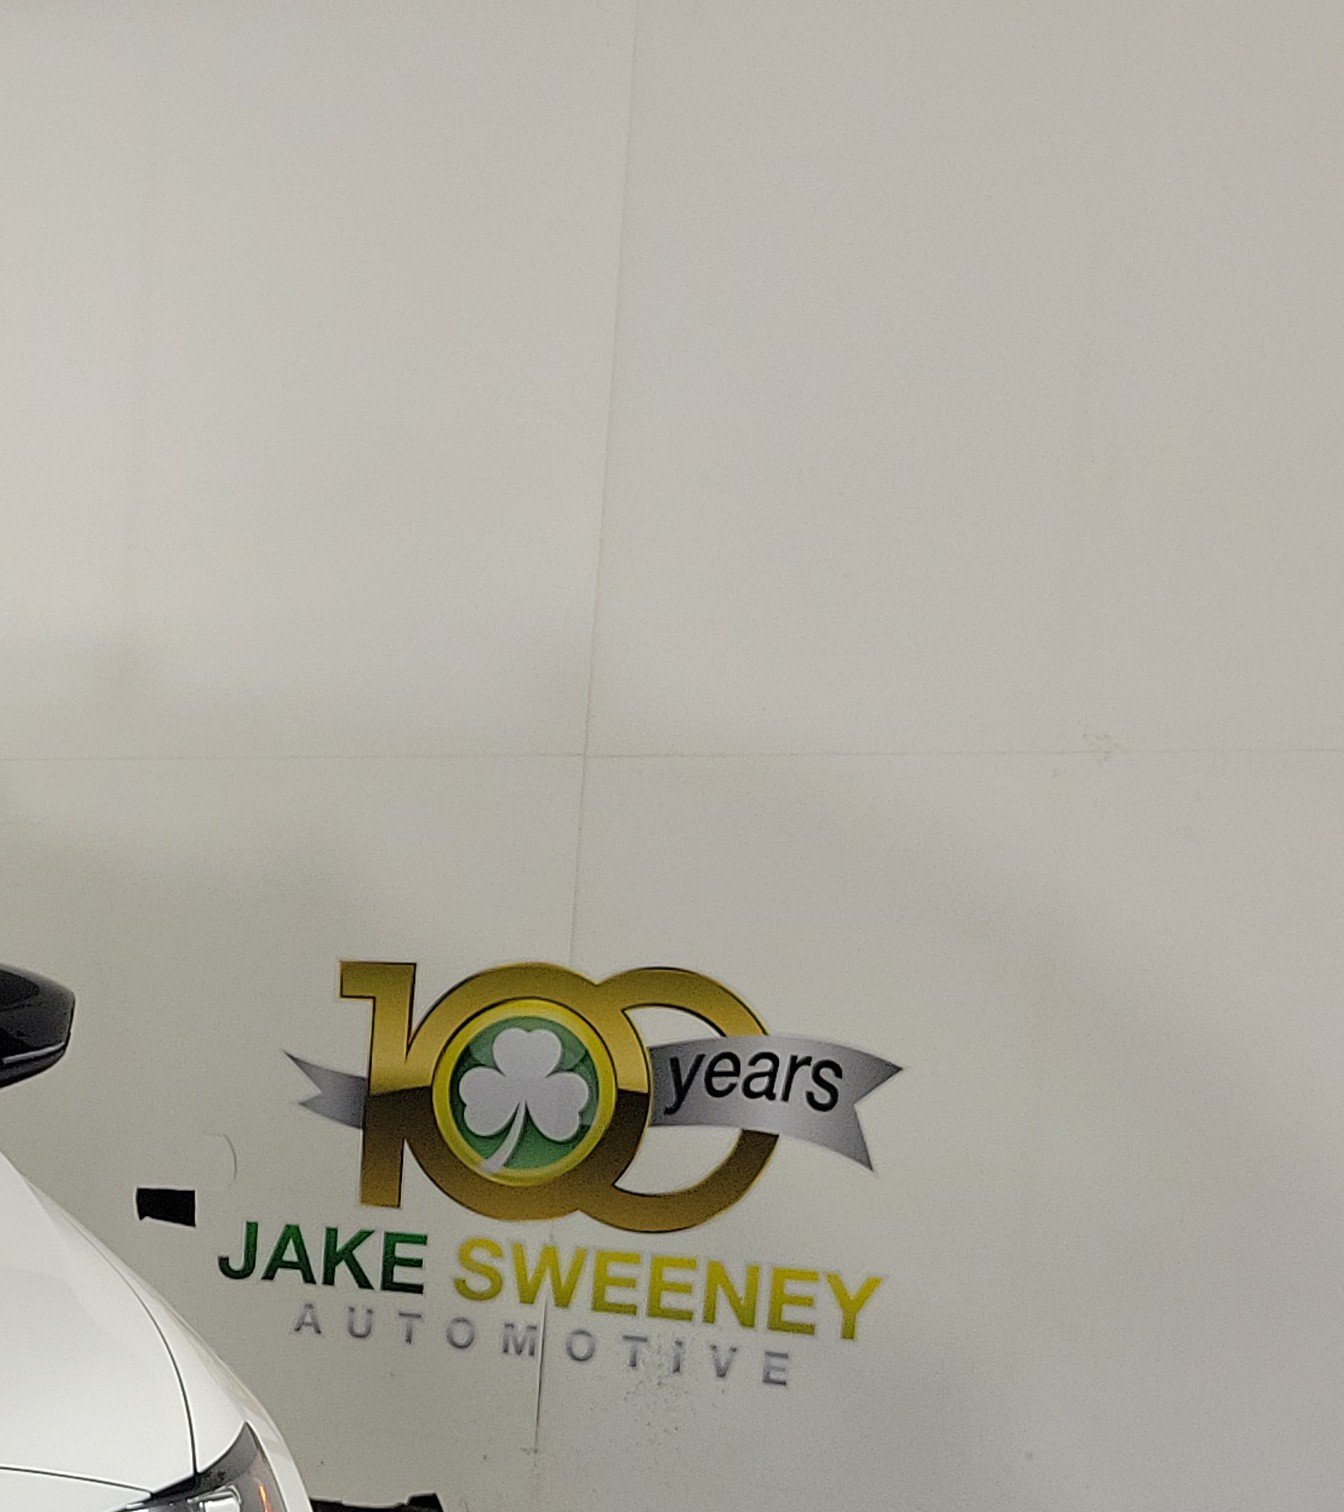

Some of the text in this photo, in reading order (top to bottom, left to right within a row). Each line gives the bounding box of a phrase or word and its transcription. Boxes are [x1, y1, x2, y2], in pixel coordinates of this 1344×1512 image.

[340, 961, 844, 1233] 100 years
[218, 1221, 882, 1340] JAKE SWEENEY
[294, 1304, 789, 1386] AUTOMOTIVE
